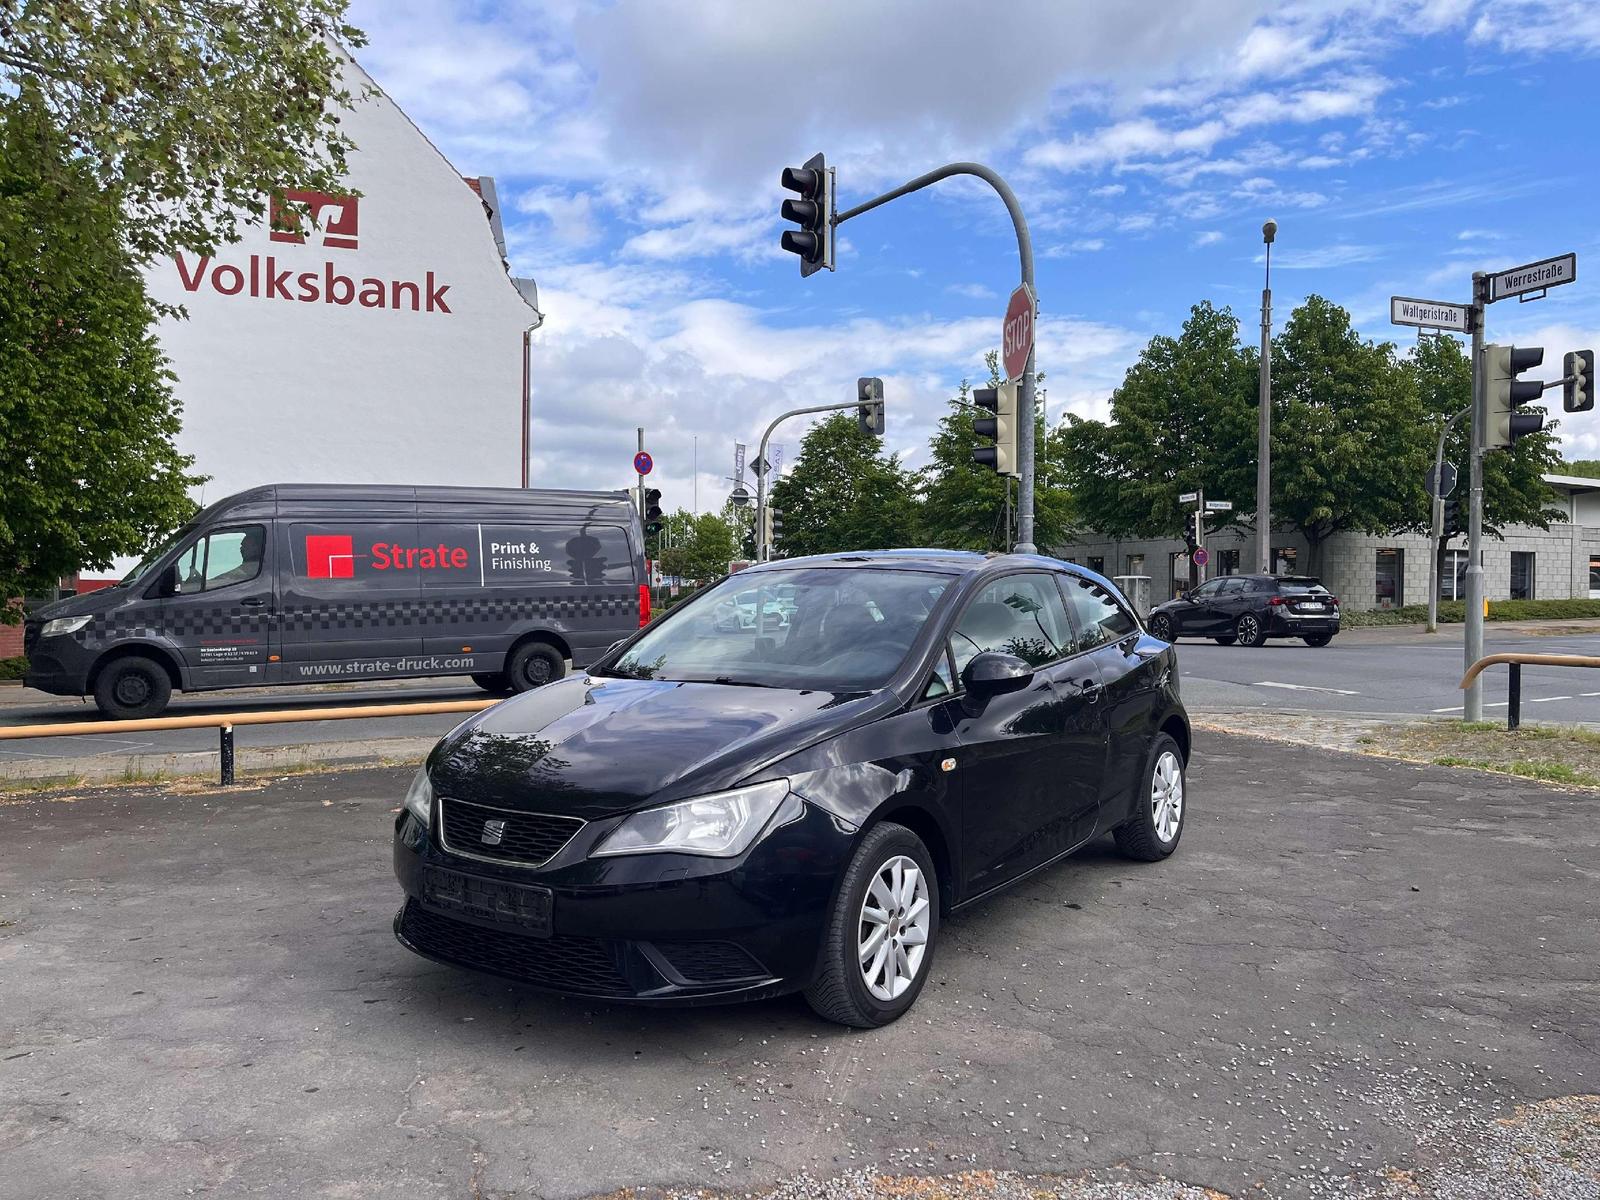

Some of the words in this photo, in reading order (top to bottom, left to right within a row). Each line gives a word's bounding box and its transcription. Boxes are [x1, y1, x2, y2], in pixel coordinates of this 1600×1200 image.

[175, 251, 452, 314] Volksbank
[1504, 264, 1563, 290] Werrestraße
[1402, 303, 1457, 323] Waltgeristraße
[1005, 310, 1030, 358] STOP
[736, 449, 744, 474] Jeep
[371, 542, 469, 570] Strate
[490, 542, 526, 555] Print
[529, 542, 540, 554] &
[492, 557, 552, 572] Finishing
[299, 656, 474, 676] www.strate-druck.com
